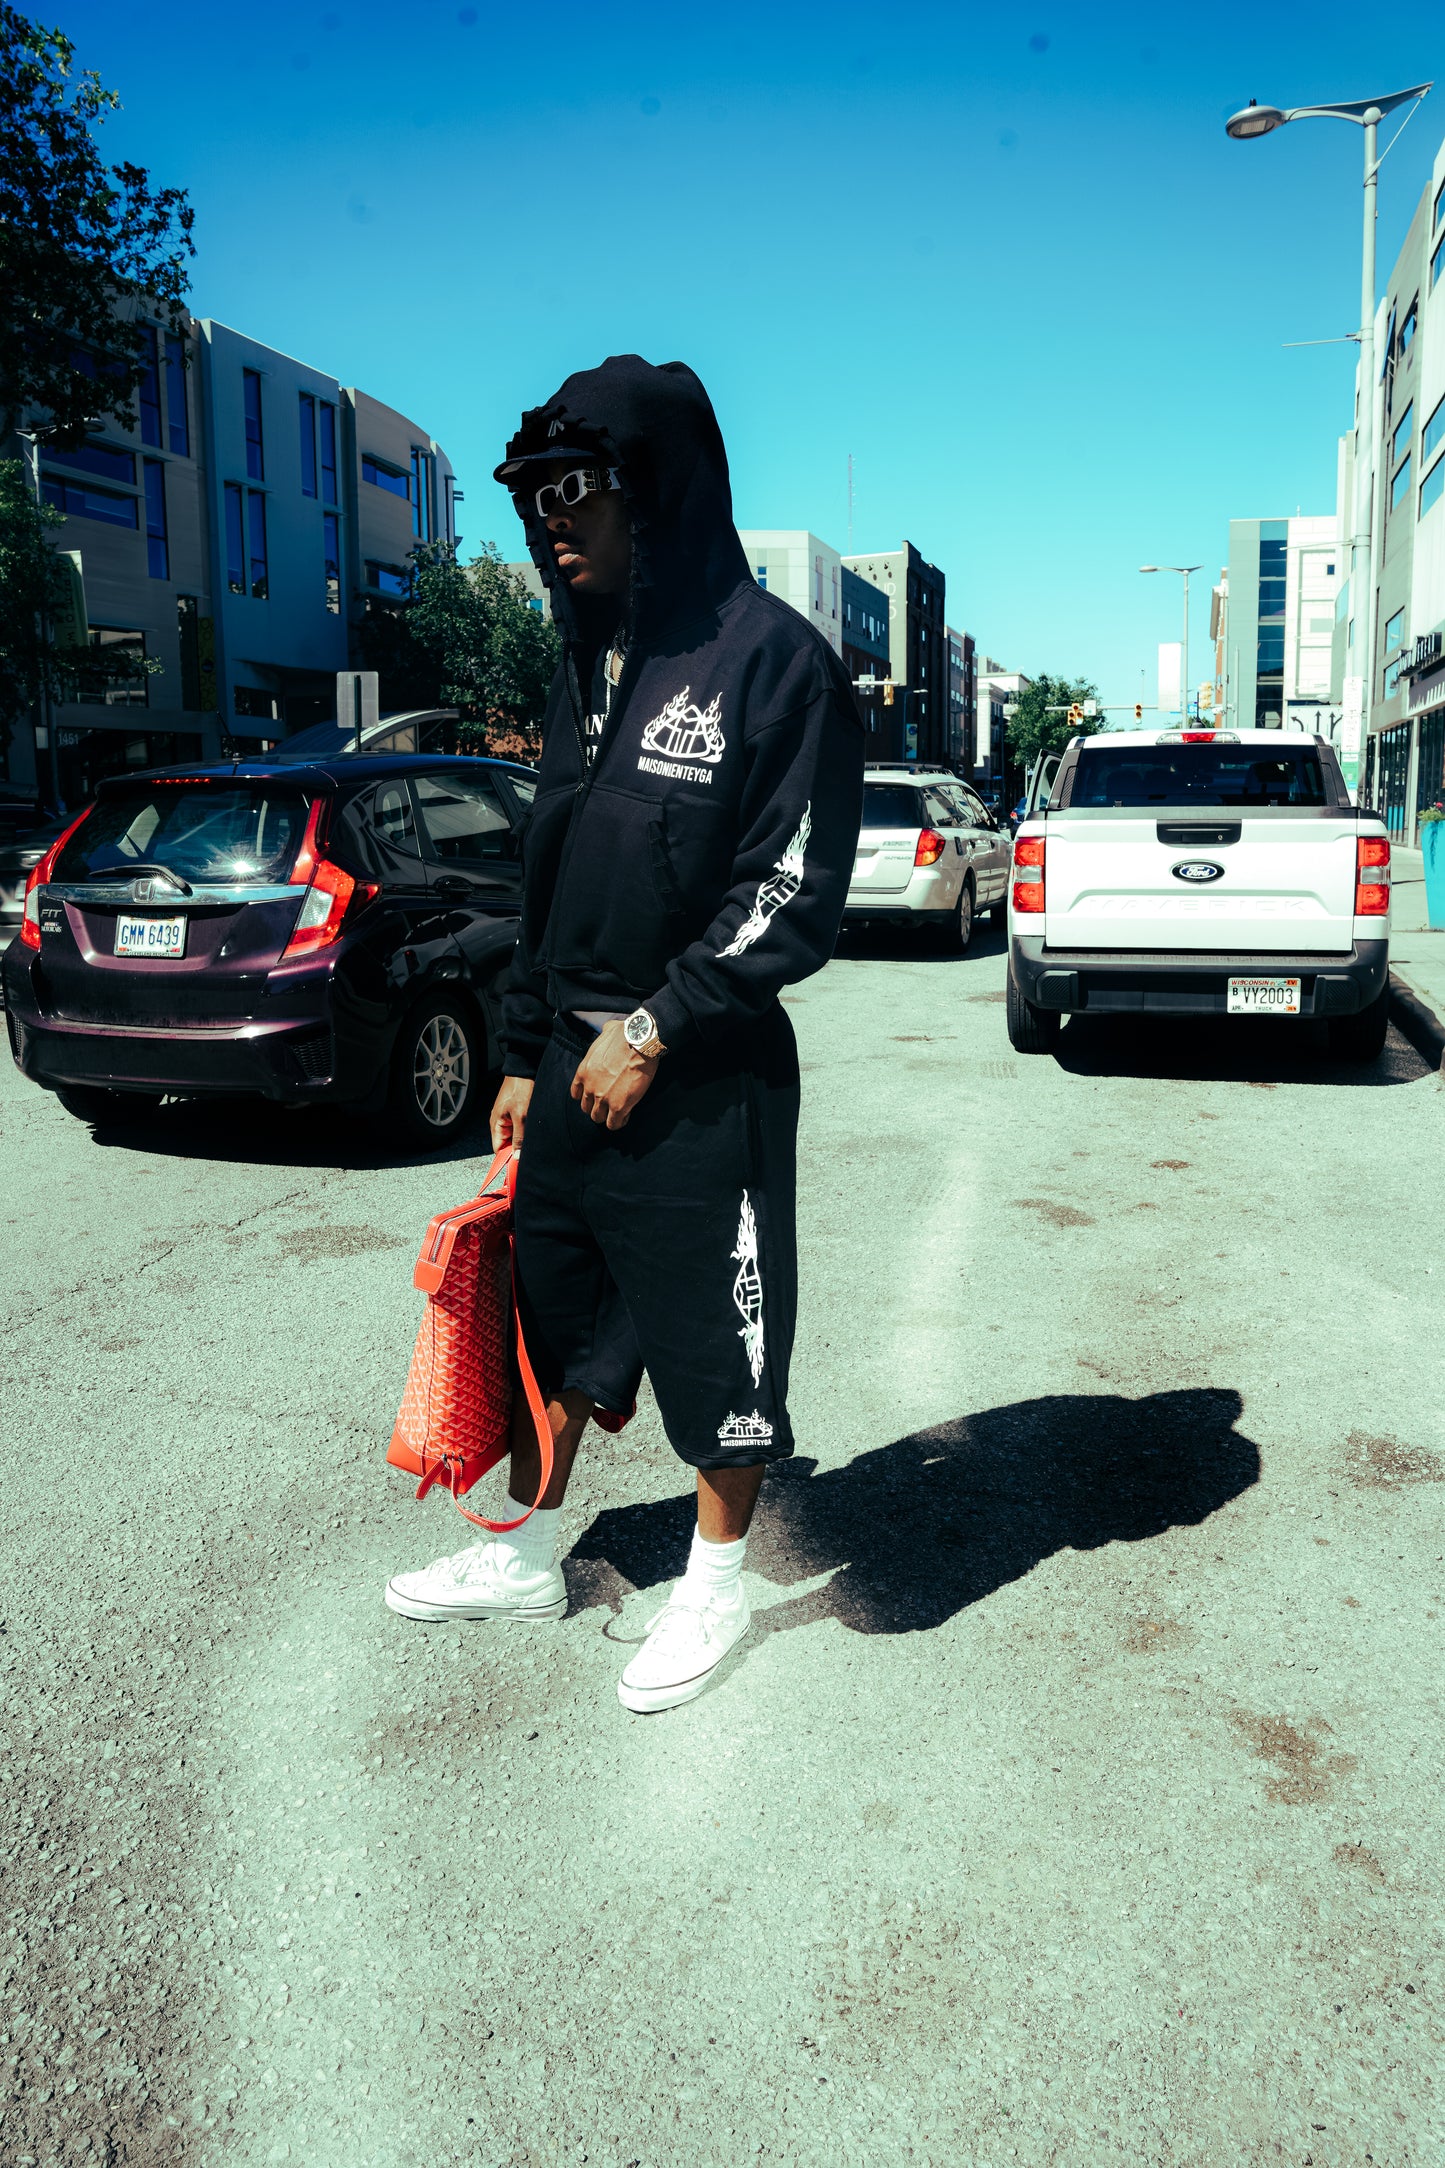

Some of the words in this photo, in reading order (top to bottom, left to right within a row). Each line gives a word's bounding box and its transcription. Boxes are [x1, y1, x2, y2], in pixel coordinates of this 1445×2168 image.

[1186, 865, 1211, 878] Ford
[41, 908, 63, 918] FIT
[121, 924, 145, 945] GMM
[148, 924, 180, 946] 6439
[1232, 987, 1239, 996] B
[1243, 987, 1294, 1004] VY2003
